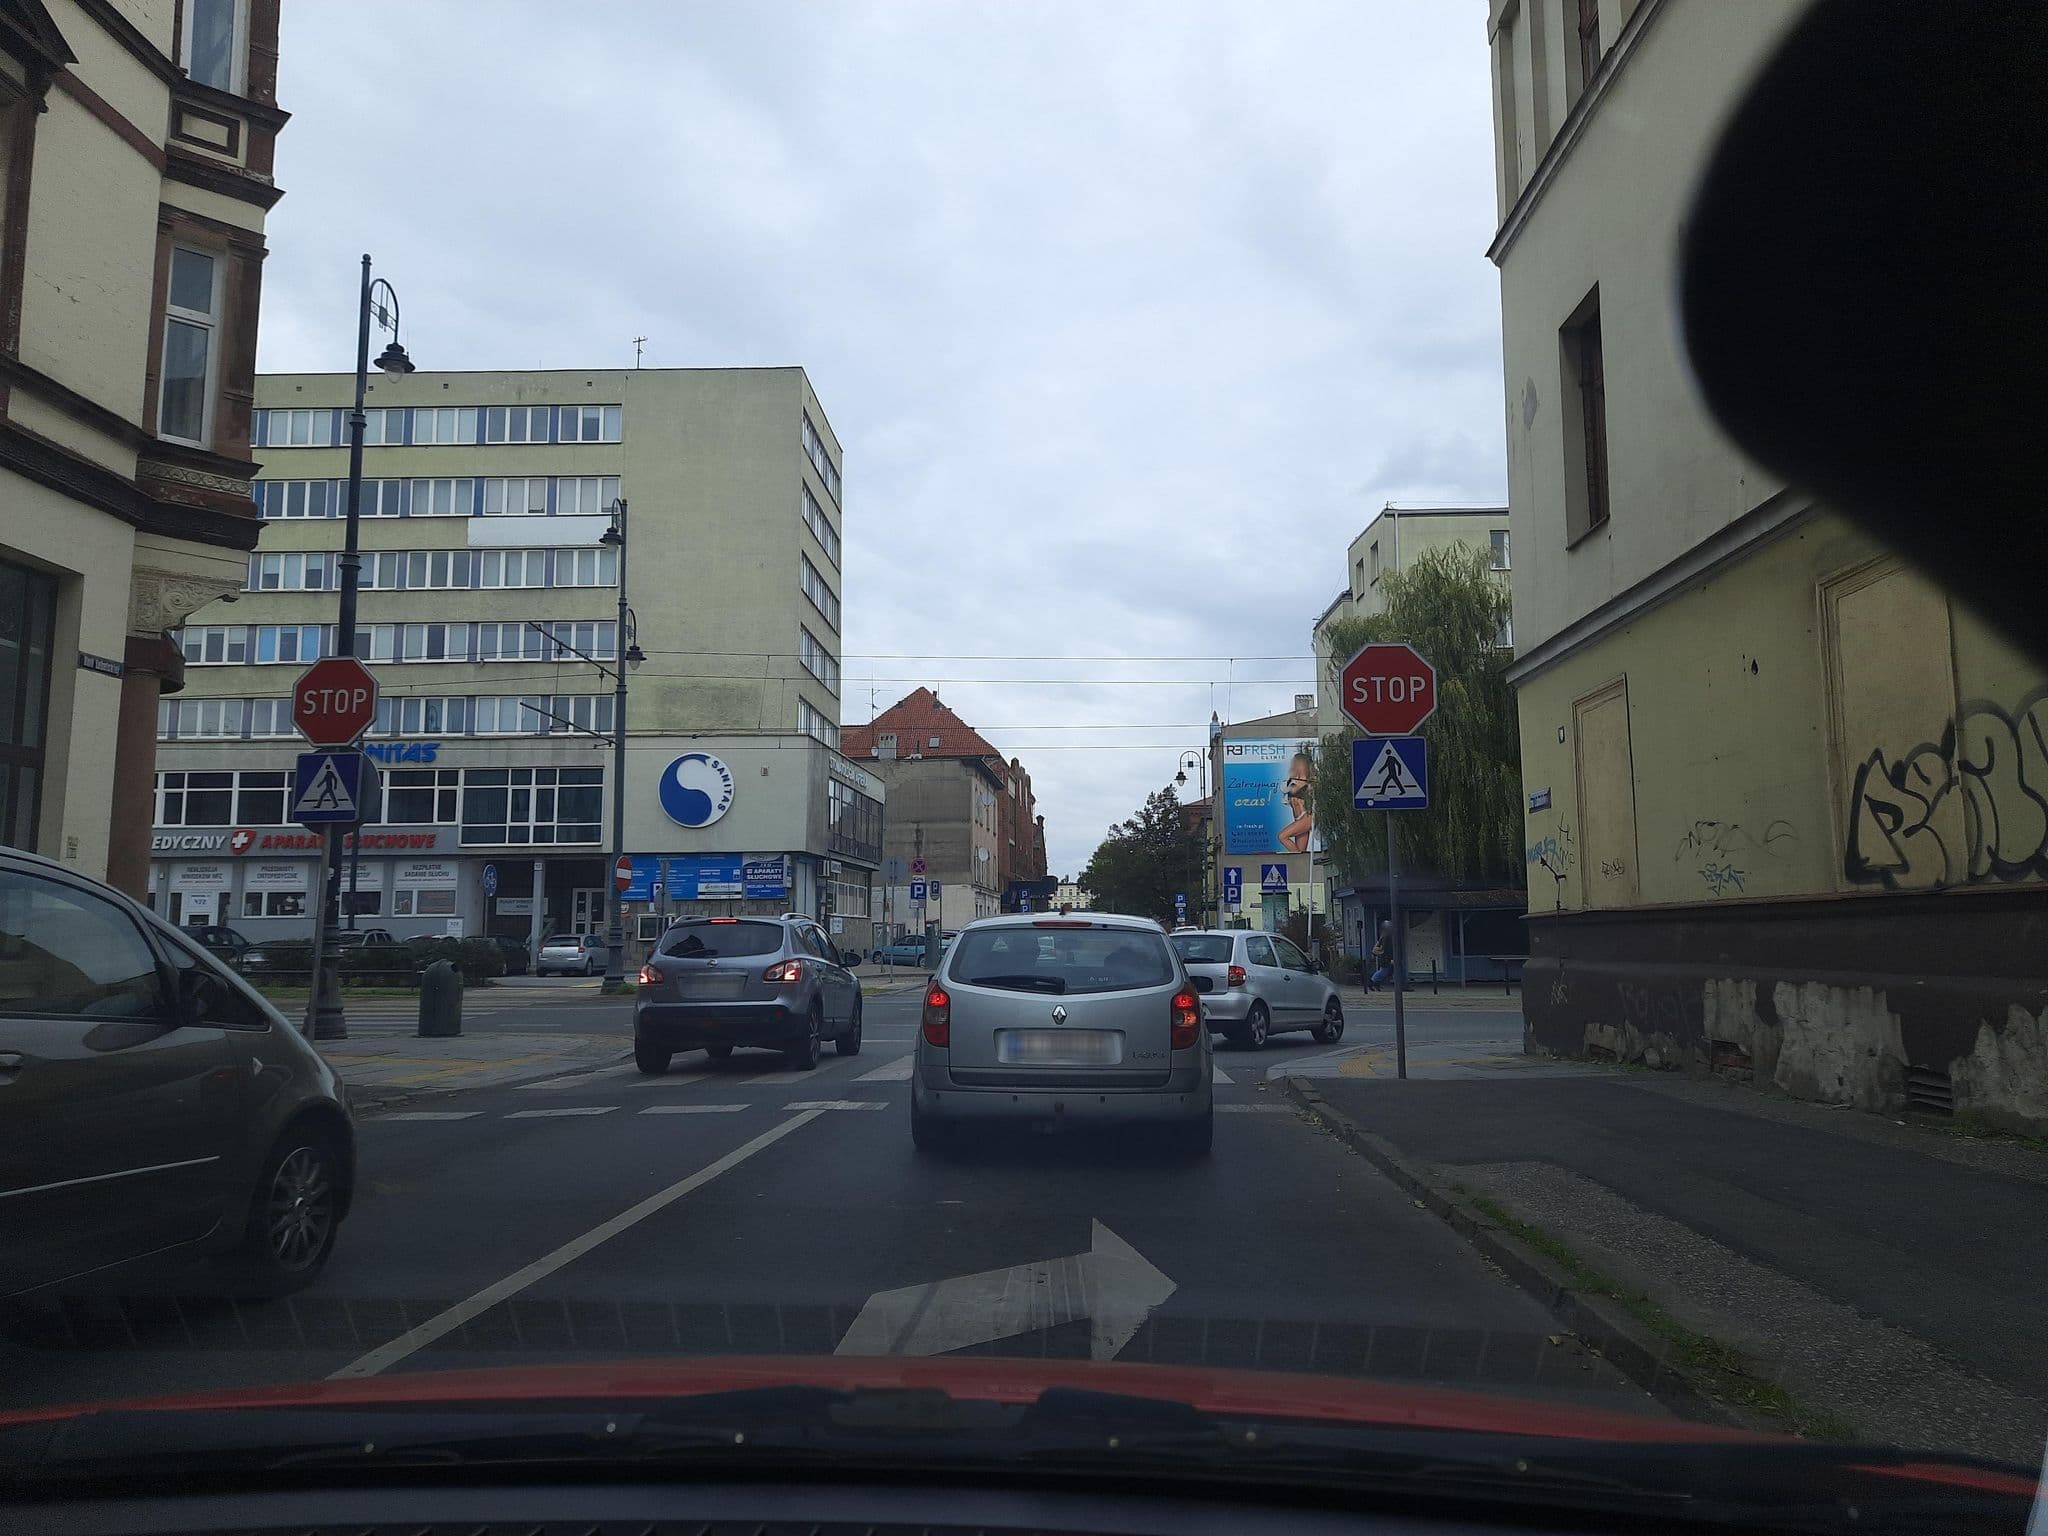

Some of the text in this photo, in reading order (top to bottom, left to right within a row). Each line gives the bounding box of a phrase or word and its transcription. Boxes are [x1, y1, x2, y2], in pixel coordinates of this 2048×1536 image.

[1352, 675, 1426, 704] STOP
[302, 688, 367, 715] STOP
[711, 760, 732, 812] SANITAS
[1228, 777, 1281, 797] Zatrzymaj
[260, 832, 325, 850] APARAT
[914, 884, 924, 897] P
[1228, 887, 1238, 901] P
